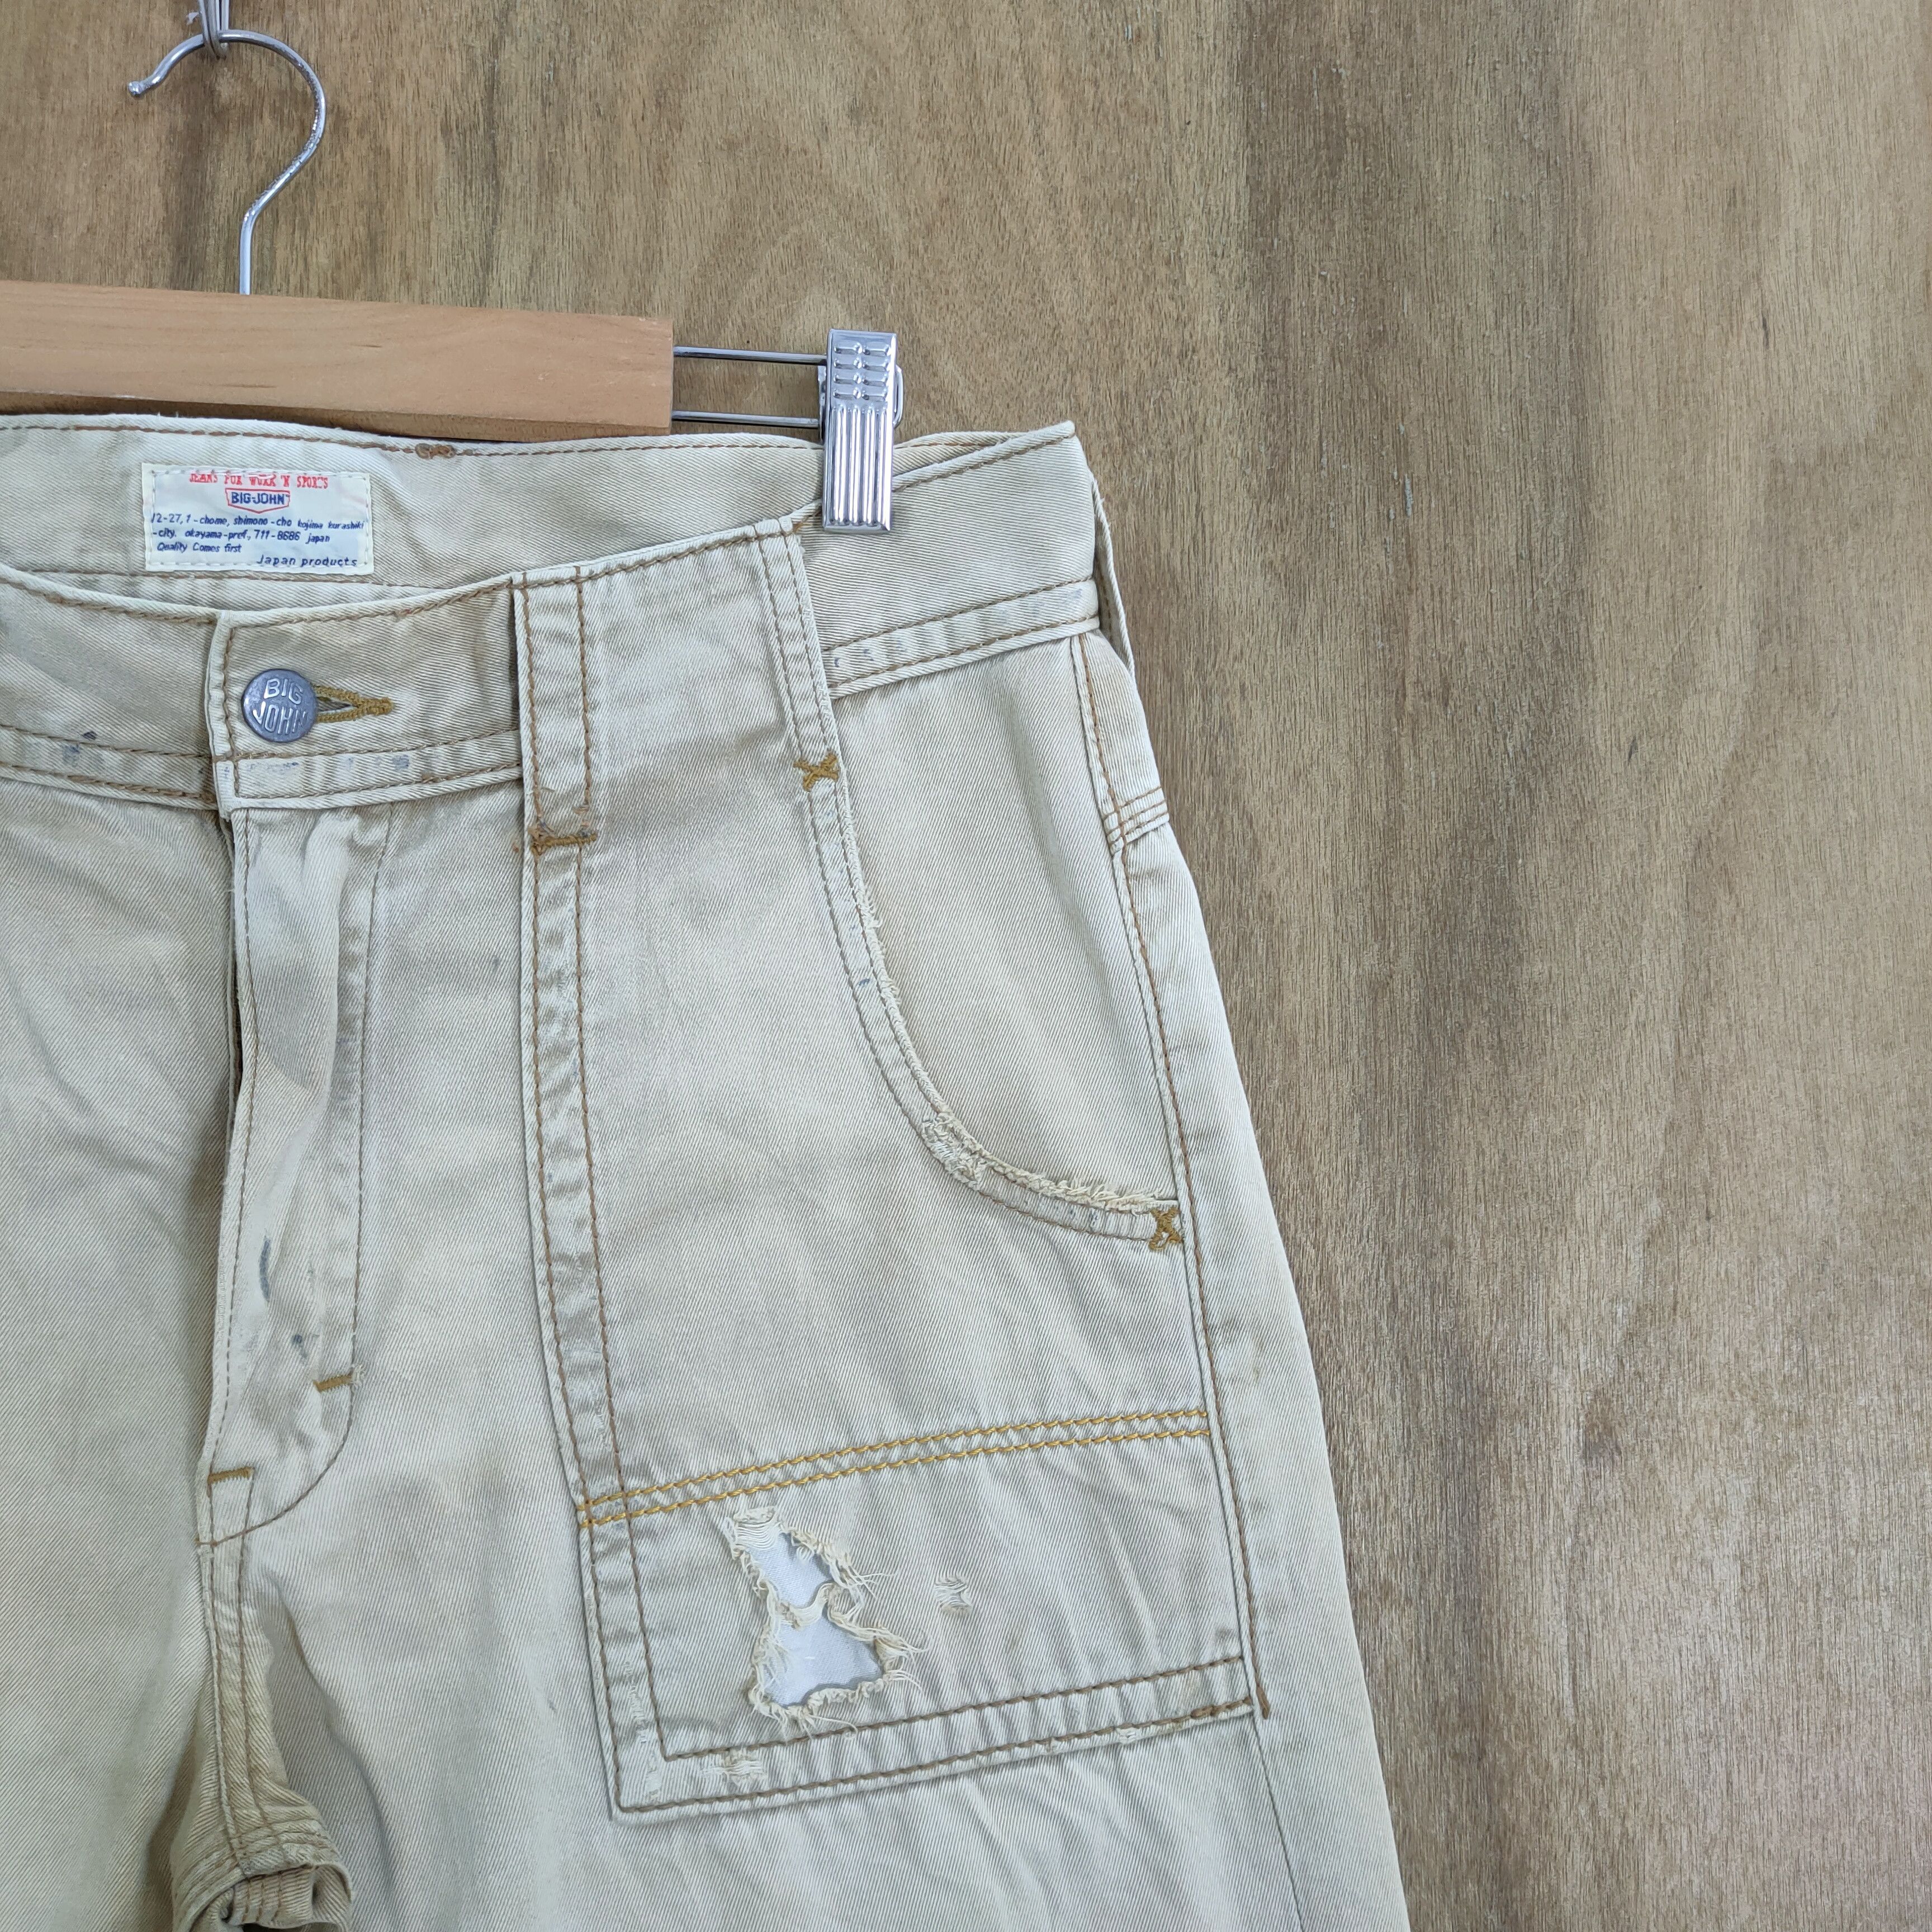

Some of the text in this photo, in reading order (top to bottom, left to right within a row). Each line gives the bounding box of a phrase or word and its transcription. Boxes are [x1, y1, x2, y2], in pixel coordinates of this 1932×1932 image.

[224, 474, 243, 485] FOR
[249, 474, 277, 487] WORK
[297, 518, 324, 531] kojima
[305, 533, 330, 544] japan
[157, 542, 242, 553] Quality Comes first
[256, 555, 358, 568] Japan products
[263, 678, 304, 704] BIG
[252, 700, 307, 735] JOHN
